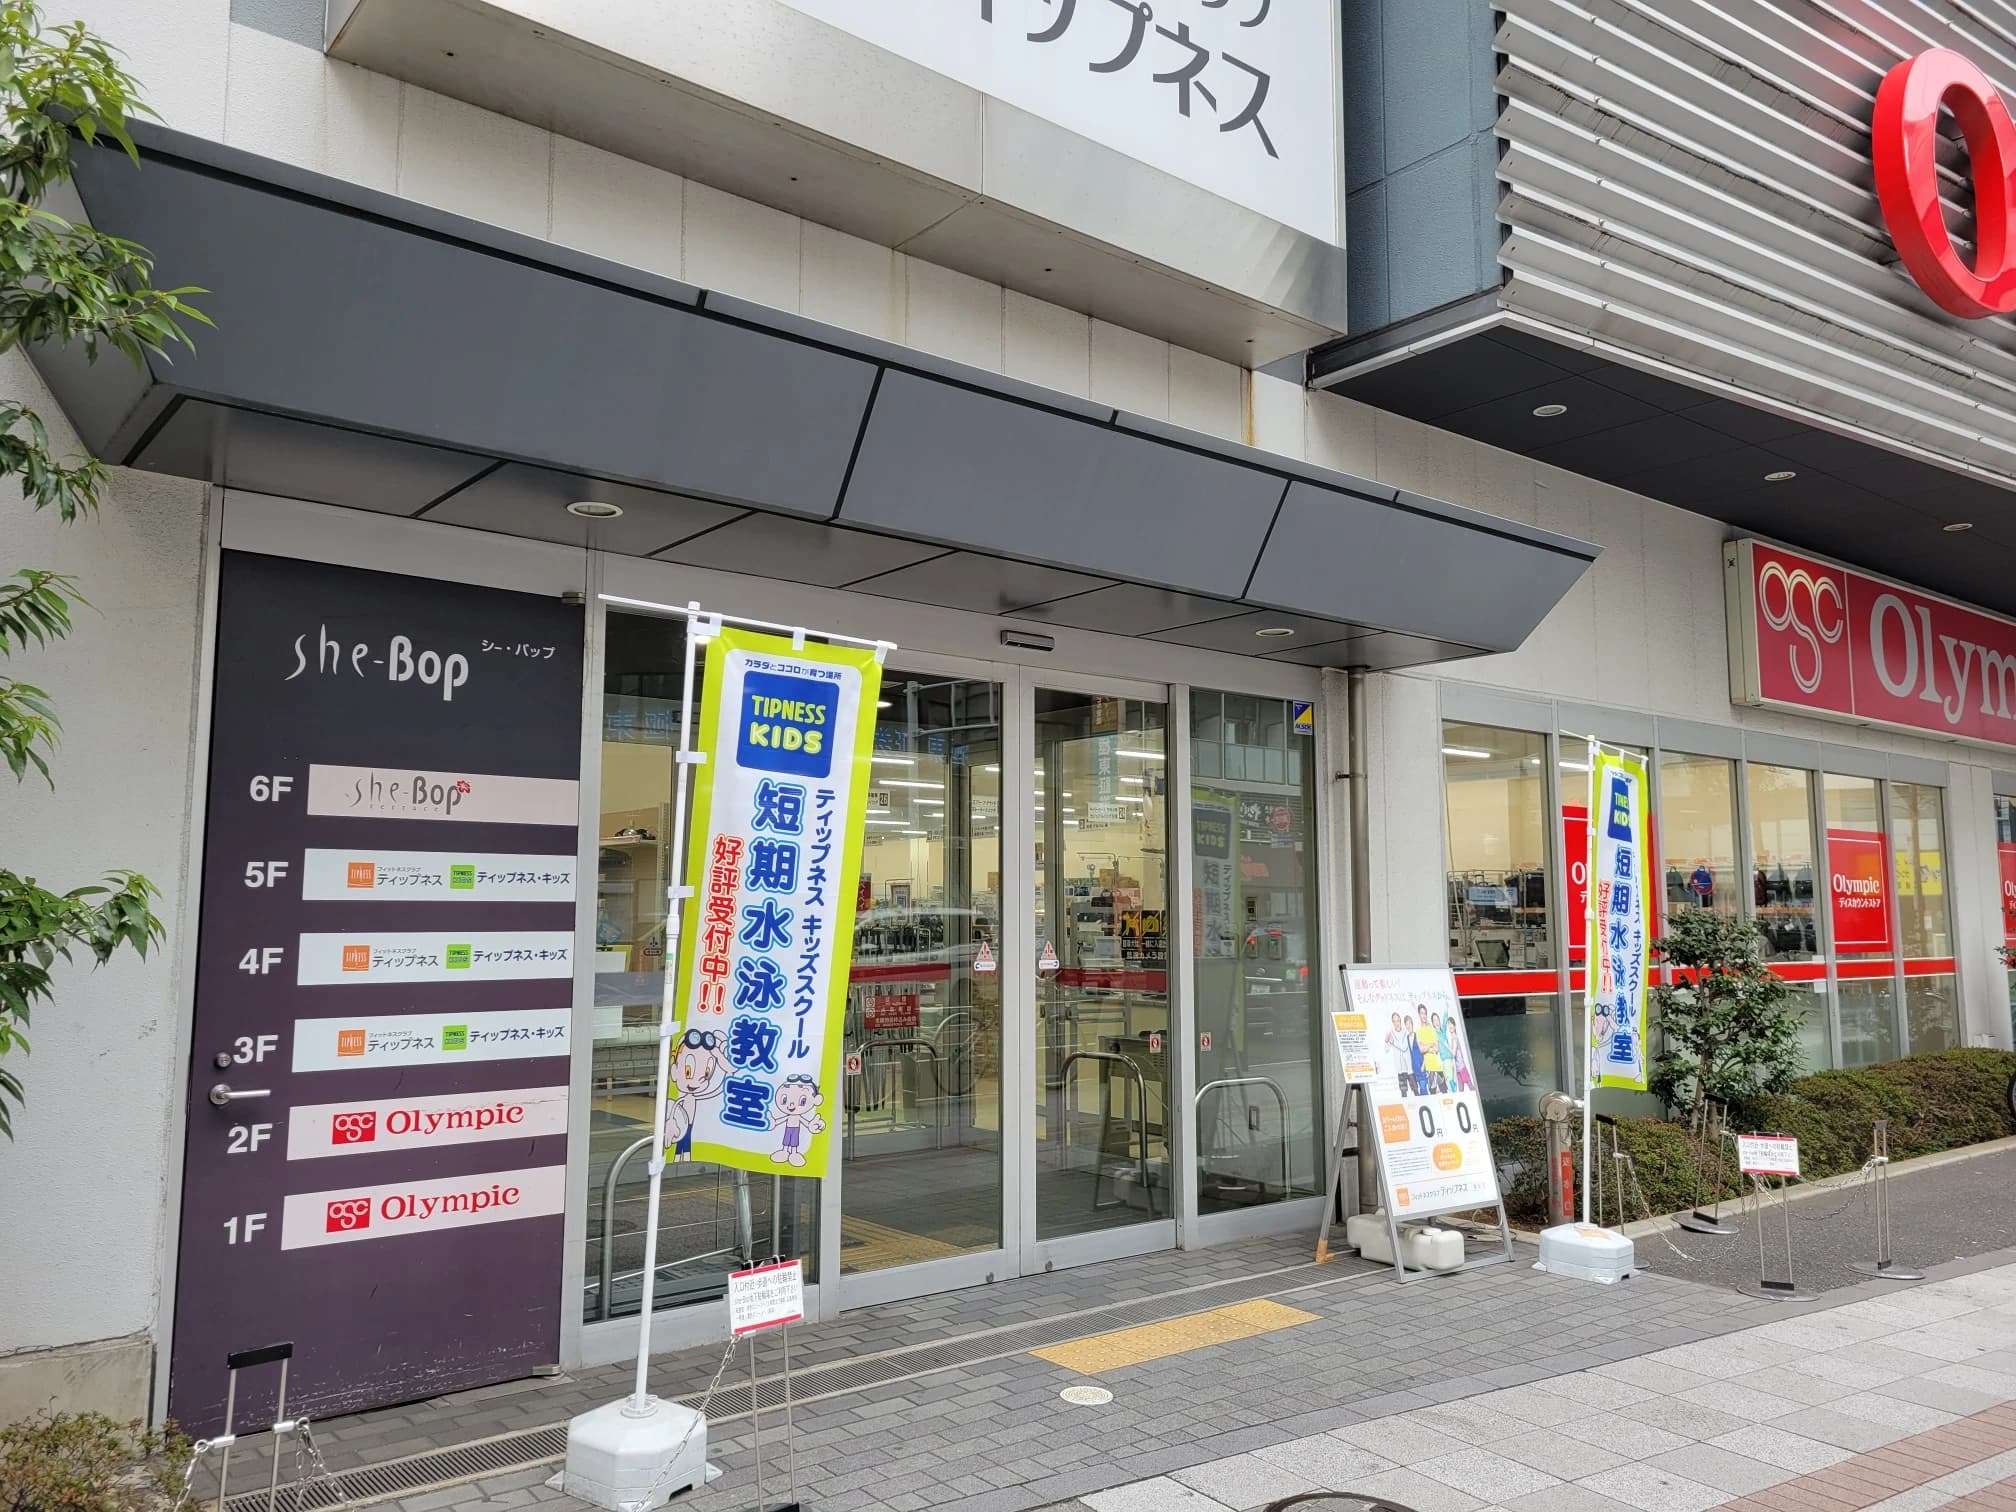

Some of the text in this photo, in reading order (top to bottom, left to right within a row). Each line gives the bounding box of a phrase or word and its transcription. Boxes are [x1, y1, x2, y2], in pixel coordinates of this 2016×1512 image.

[745, 659, 842, 680] カラダとココロが育つ場所
[752, 695, 826, 725] TIPNESS
[749, 722, 823, 754] KIDS
[249, 774, 294, 802] 6F
[243, 861, 289, 888] 5F
[377, 873, 443, 886] ティップネス
[476, 871, 571, 885] ティップネス・キッズ
[1833, 874, 1880, 896] Olympic
[788, 789, 836, 1059] ティップネス キッズスクール
[239, 947, 284, 975] 4F
[372, 954, 438, 968] ティップネス
[473, 949, 568, 962] ティップネス・キッズ
[722, 780, 806, 1131] 短期水泳教室
[368, 1037, 434, 1052] ティップネス
[469, 1025, 565, 1043] ティップネス・キッズ
[233, 1034, 279, 1064] 3F
[386, 1103, 524, 1135] Olympic
[227, 1123, 273, 1154] 2F
[381, 1185, 520, 1220] Olympic
[223, 1212, 268, 1245] 1F
